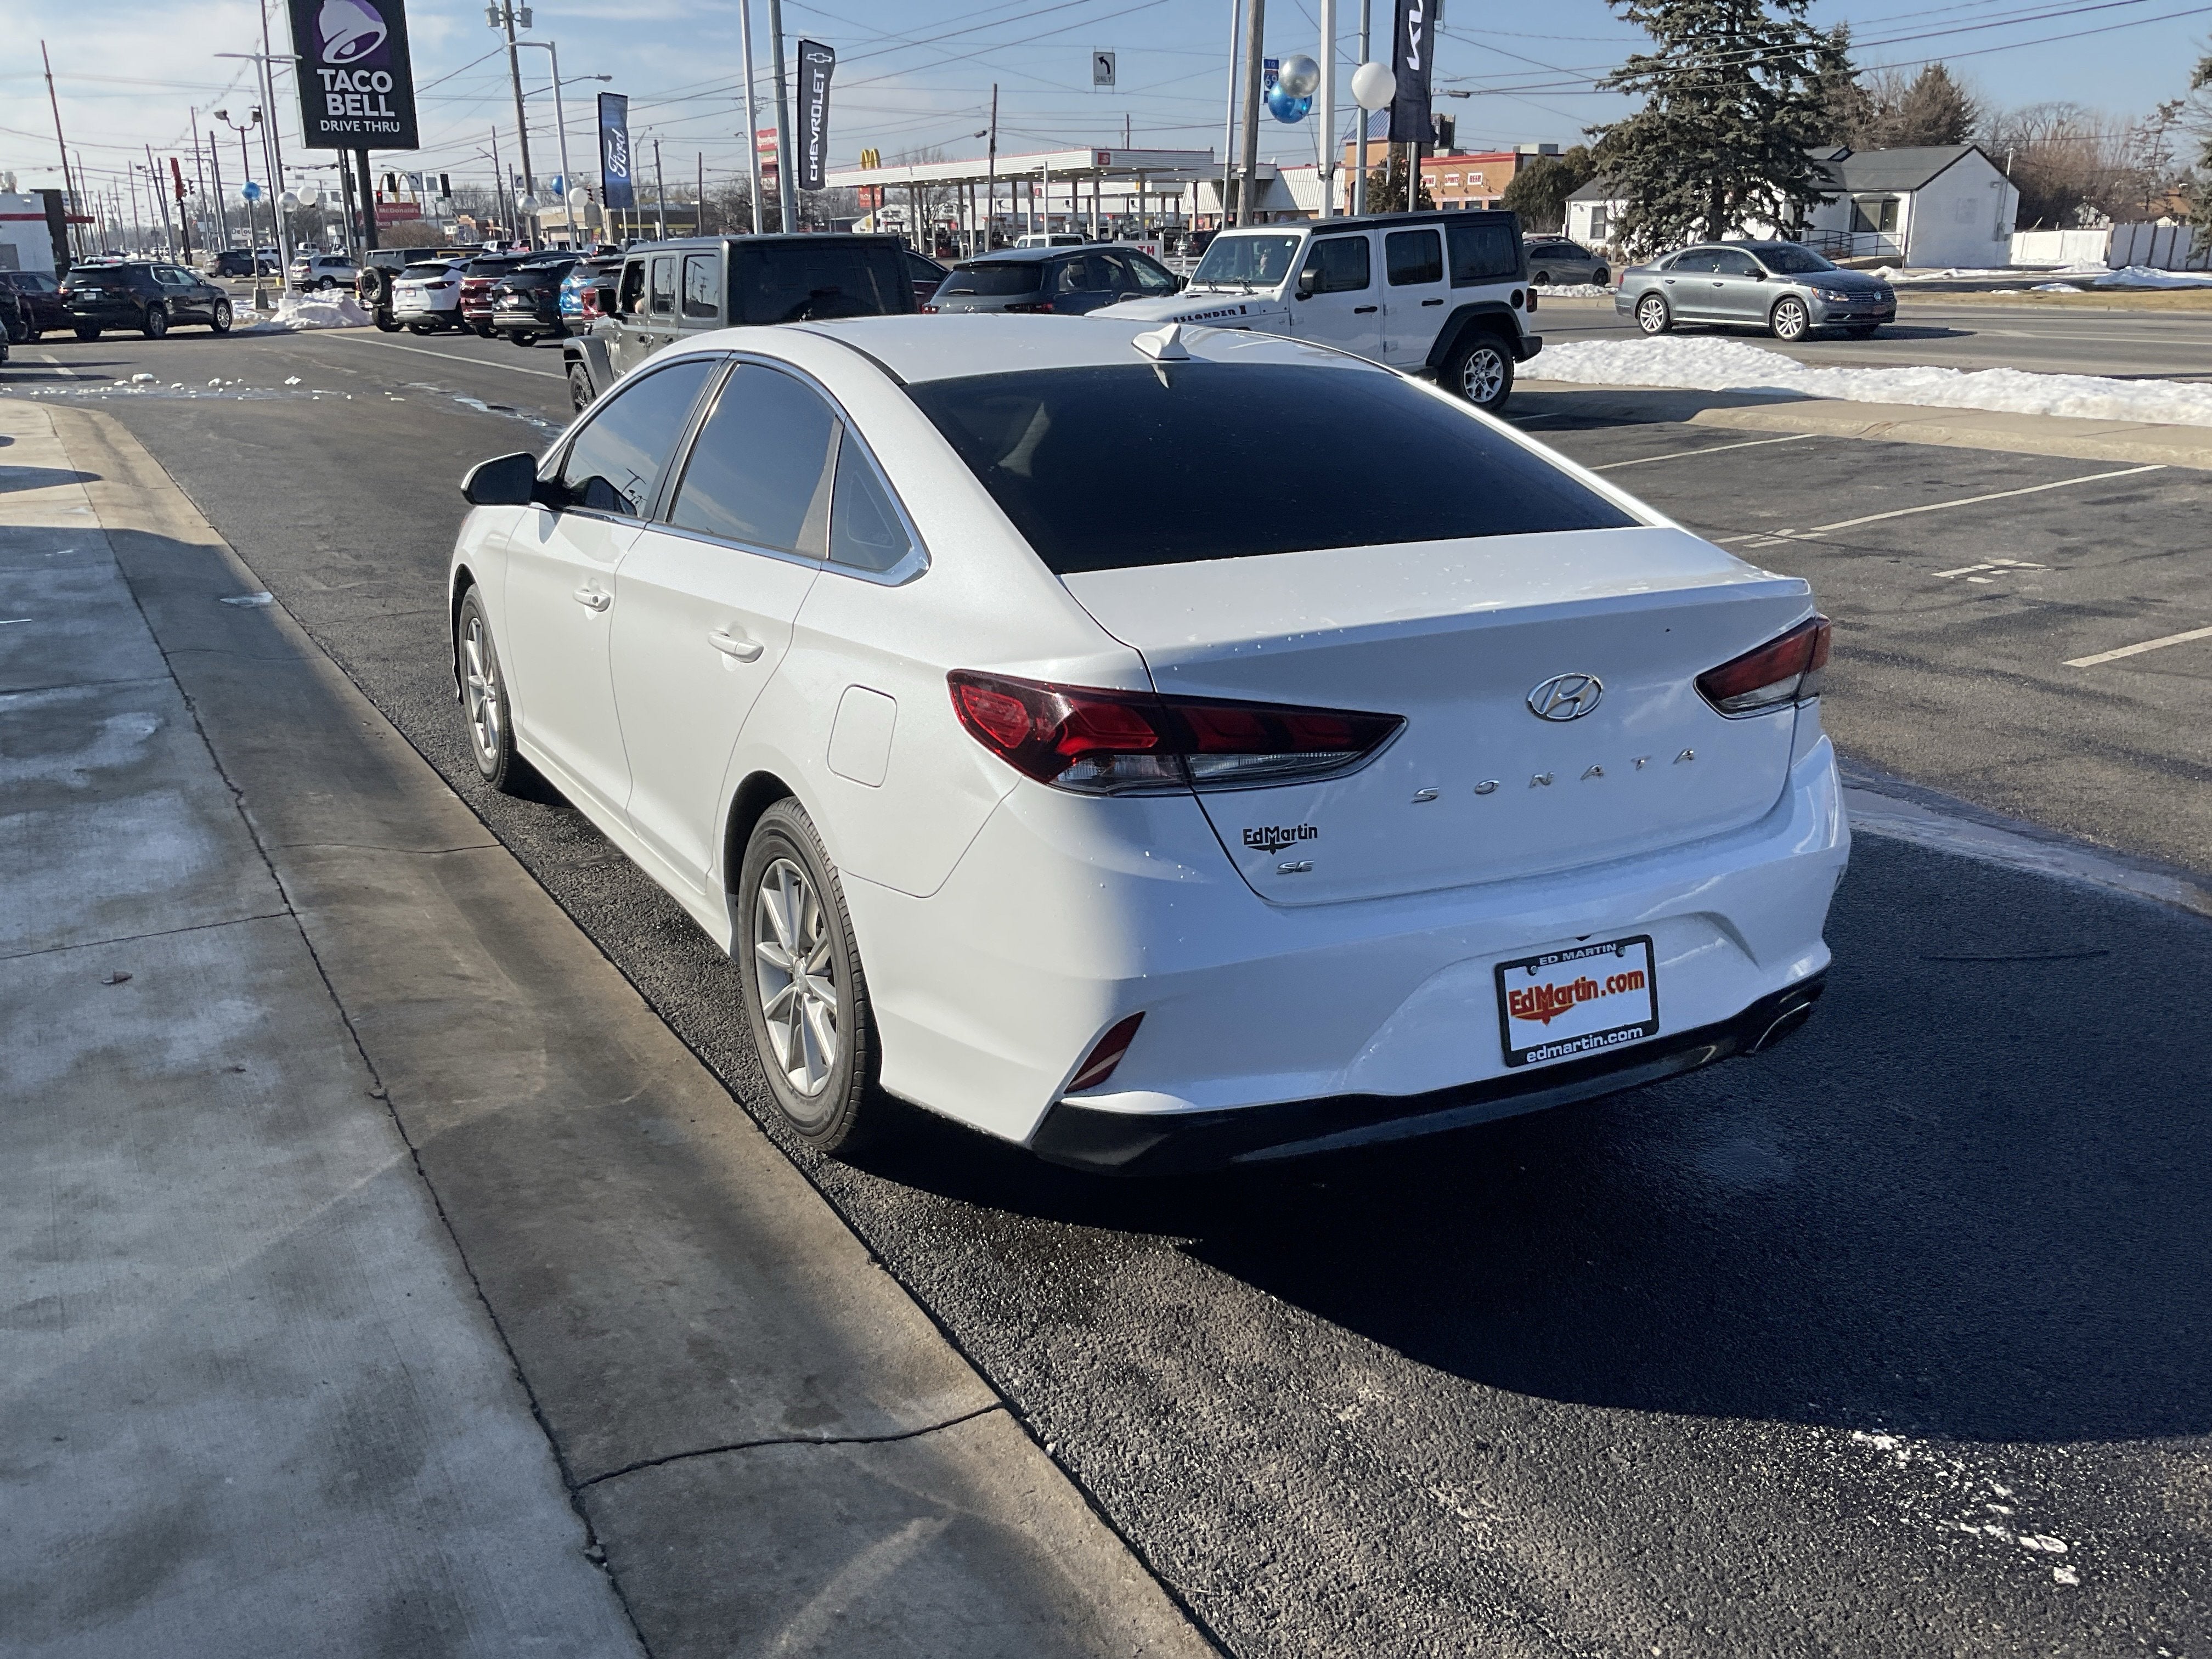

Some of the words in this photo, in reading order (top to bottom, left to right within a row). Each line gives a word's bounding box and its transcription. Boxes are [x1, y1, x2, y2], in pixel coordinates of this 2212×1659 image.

[317, 69, 393, 93] TACO
[1265, 75, 1278, 86] 69
[326, 93, 395, 117] BELL
[320, 120, 360, 132] DRIVE
[363, 121, 400, 132] THRU
[809, 69, 825, 181] CHEVROLET
[607, 127, 627, 178] Ford
[1137, 245, 1155, 256] TM
[1173, 309, 1237, 323] ISLANDER
[1412, 748, 1695, 804] SONATA
[1276, 859, 1315, 875] SE
[1539, 955, 1558, 966] ED
[1563, 943, 1616, 961] MARTIN
[1509, 970, 1645, 1015] EdMartin.com
[1526, 1027, 1643, 1063] edmartin.com
